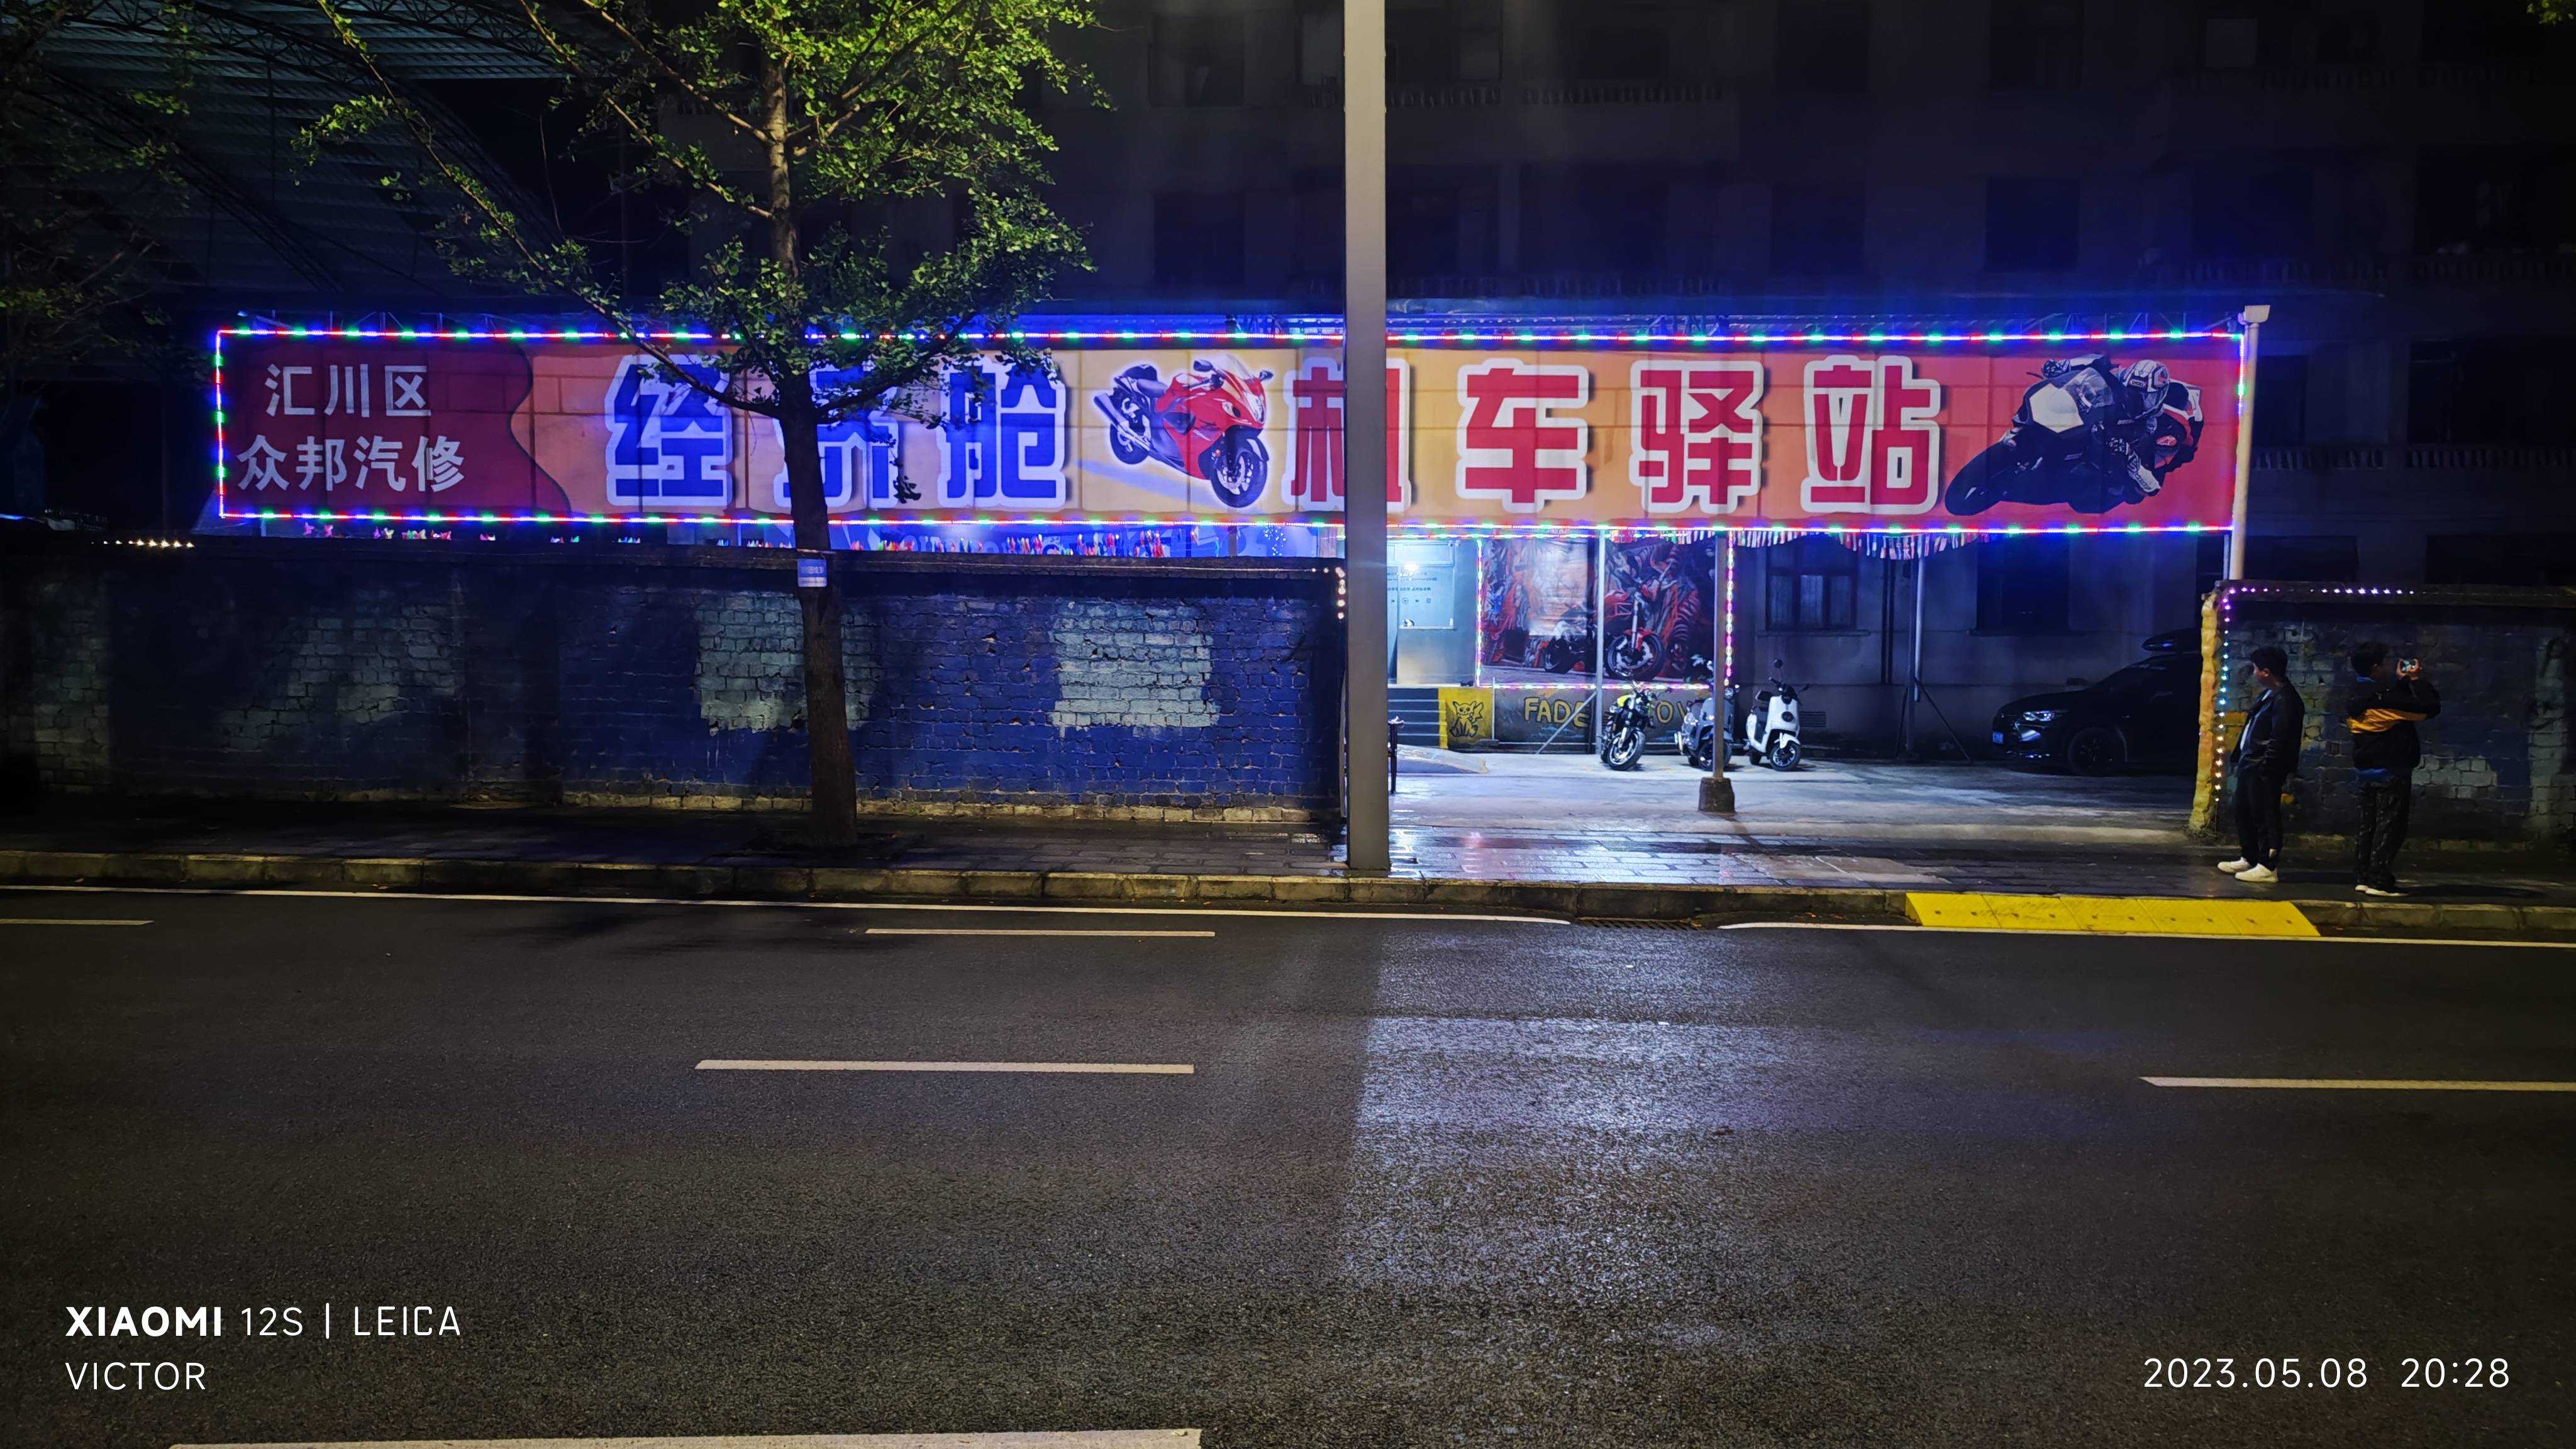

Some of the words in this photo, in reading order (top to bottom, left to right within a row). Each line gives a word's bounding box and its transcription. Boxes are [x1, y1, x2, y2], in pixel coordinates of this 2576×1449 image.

[264, 363, 432, 418] 汇川区
[236, 434, 465, 492] 众邦汽修
[1287, 362, 1936, 508] 机车驿站
[1524, 696, 1590, 728] FADE
